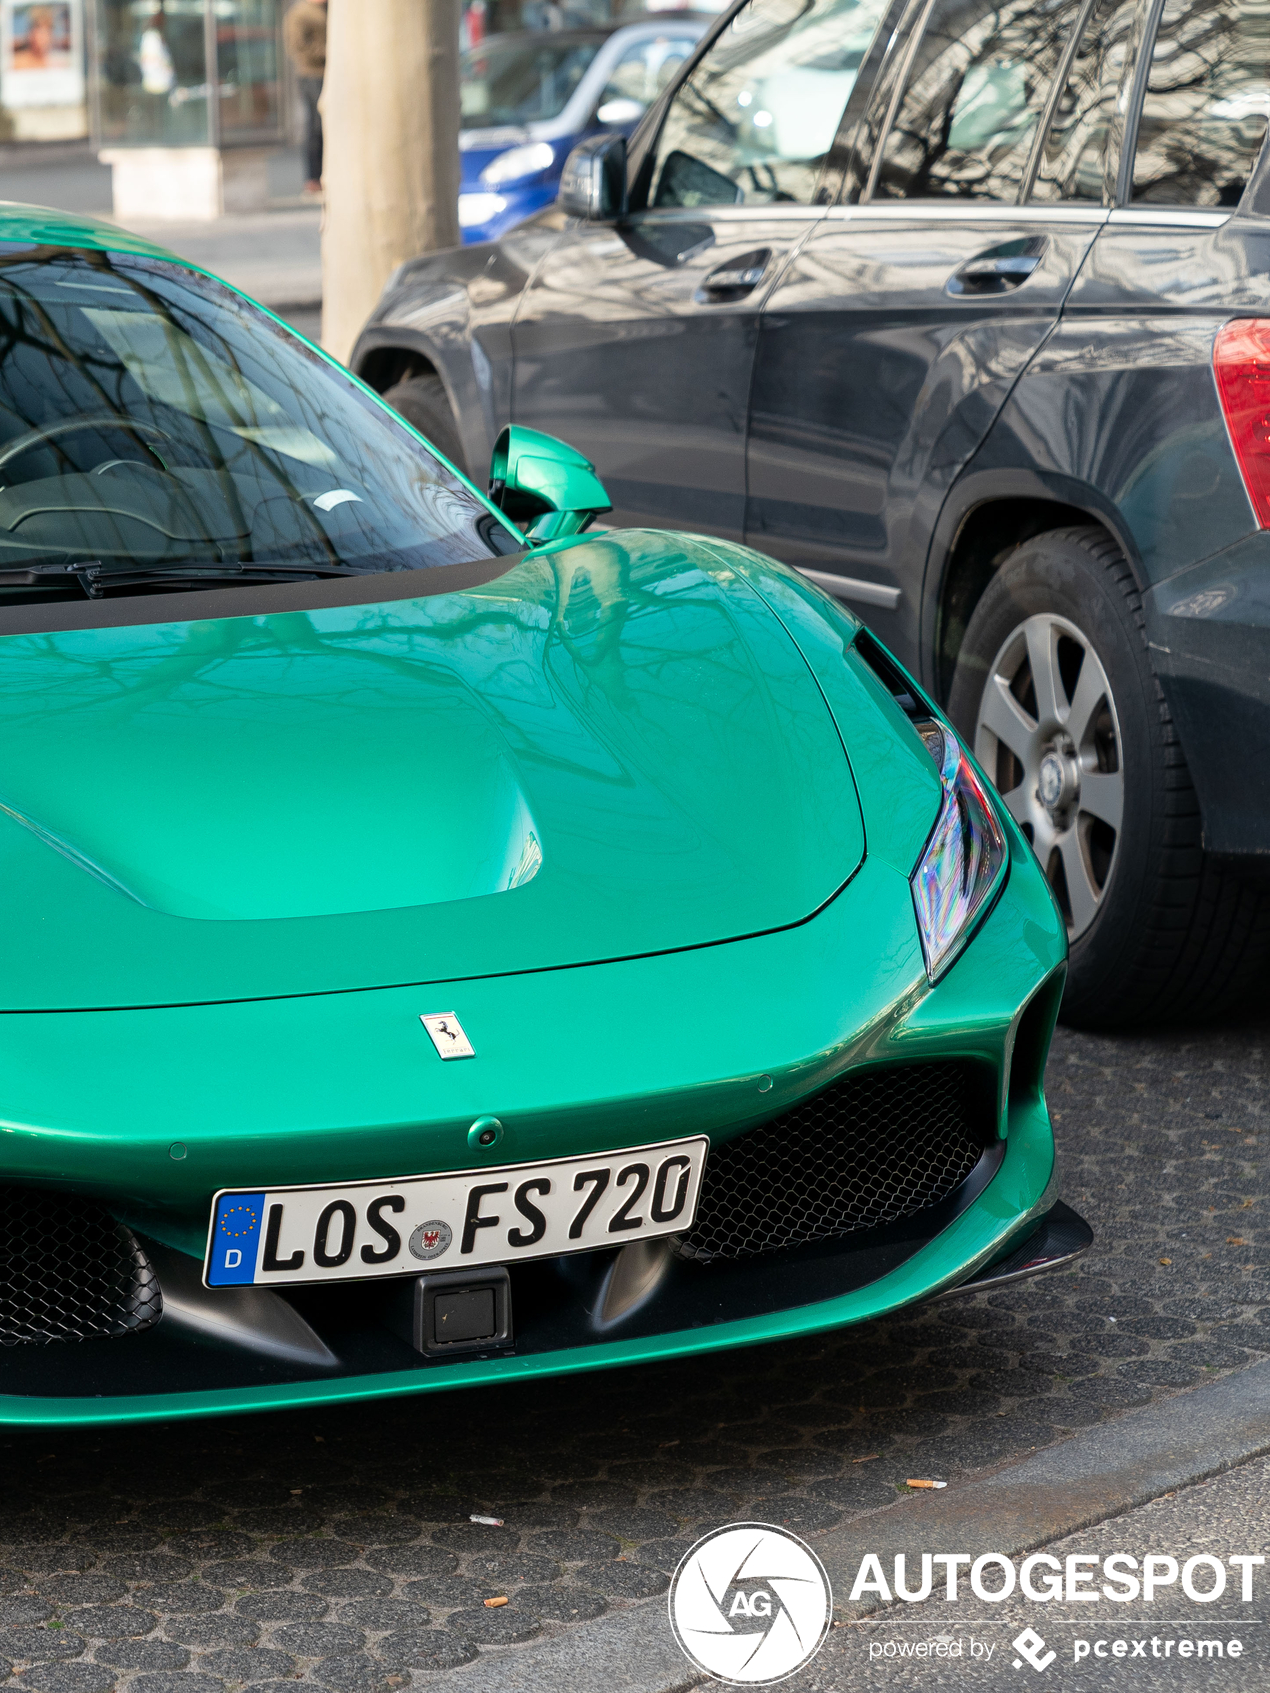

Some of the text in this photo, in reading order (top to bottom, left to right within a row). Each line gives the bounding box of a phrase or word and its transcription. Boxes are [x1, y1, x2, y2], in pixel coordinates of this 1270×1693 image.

[262, 1154, 693, 1273] LOS FS 720
[224, 1248, 243, 1269] D
